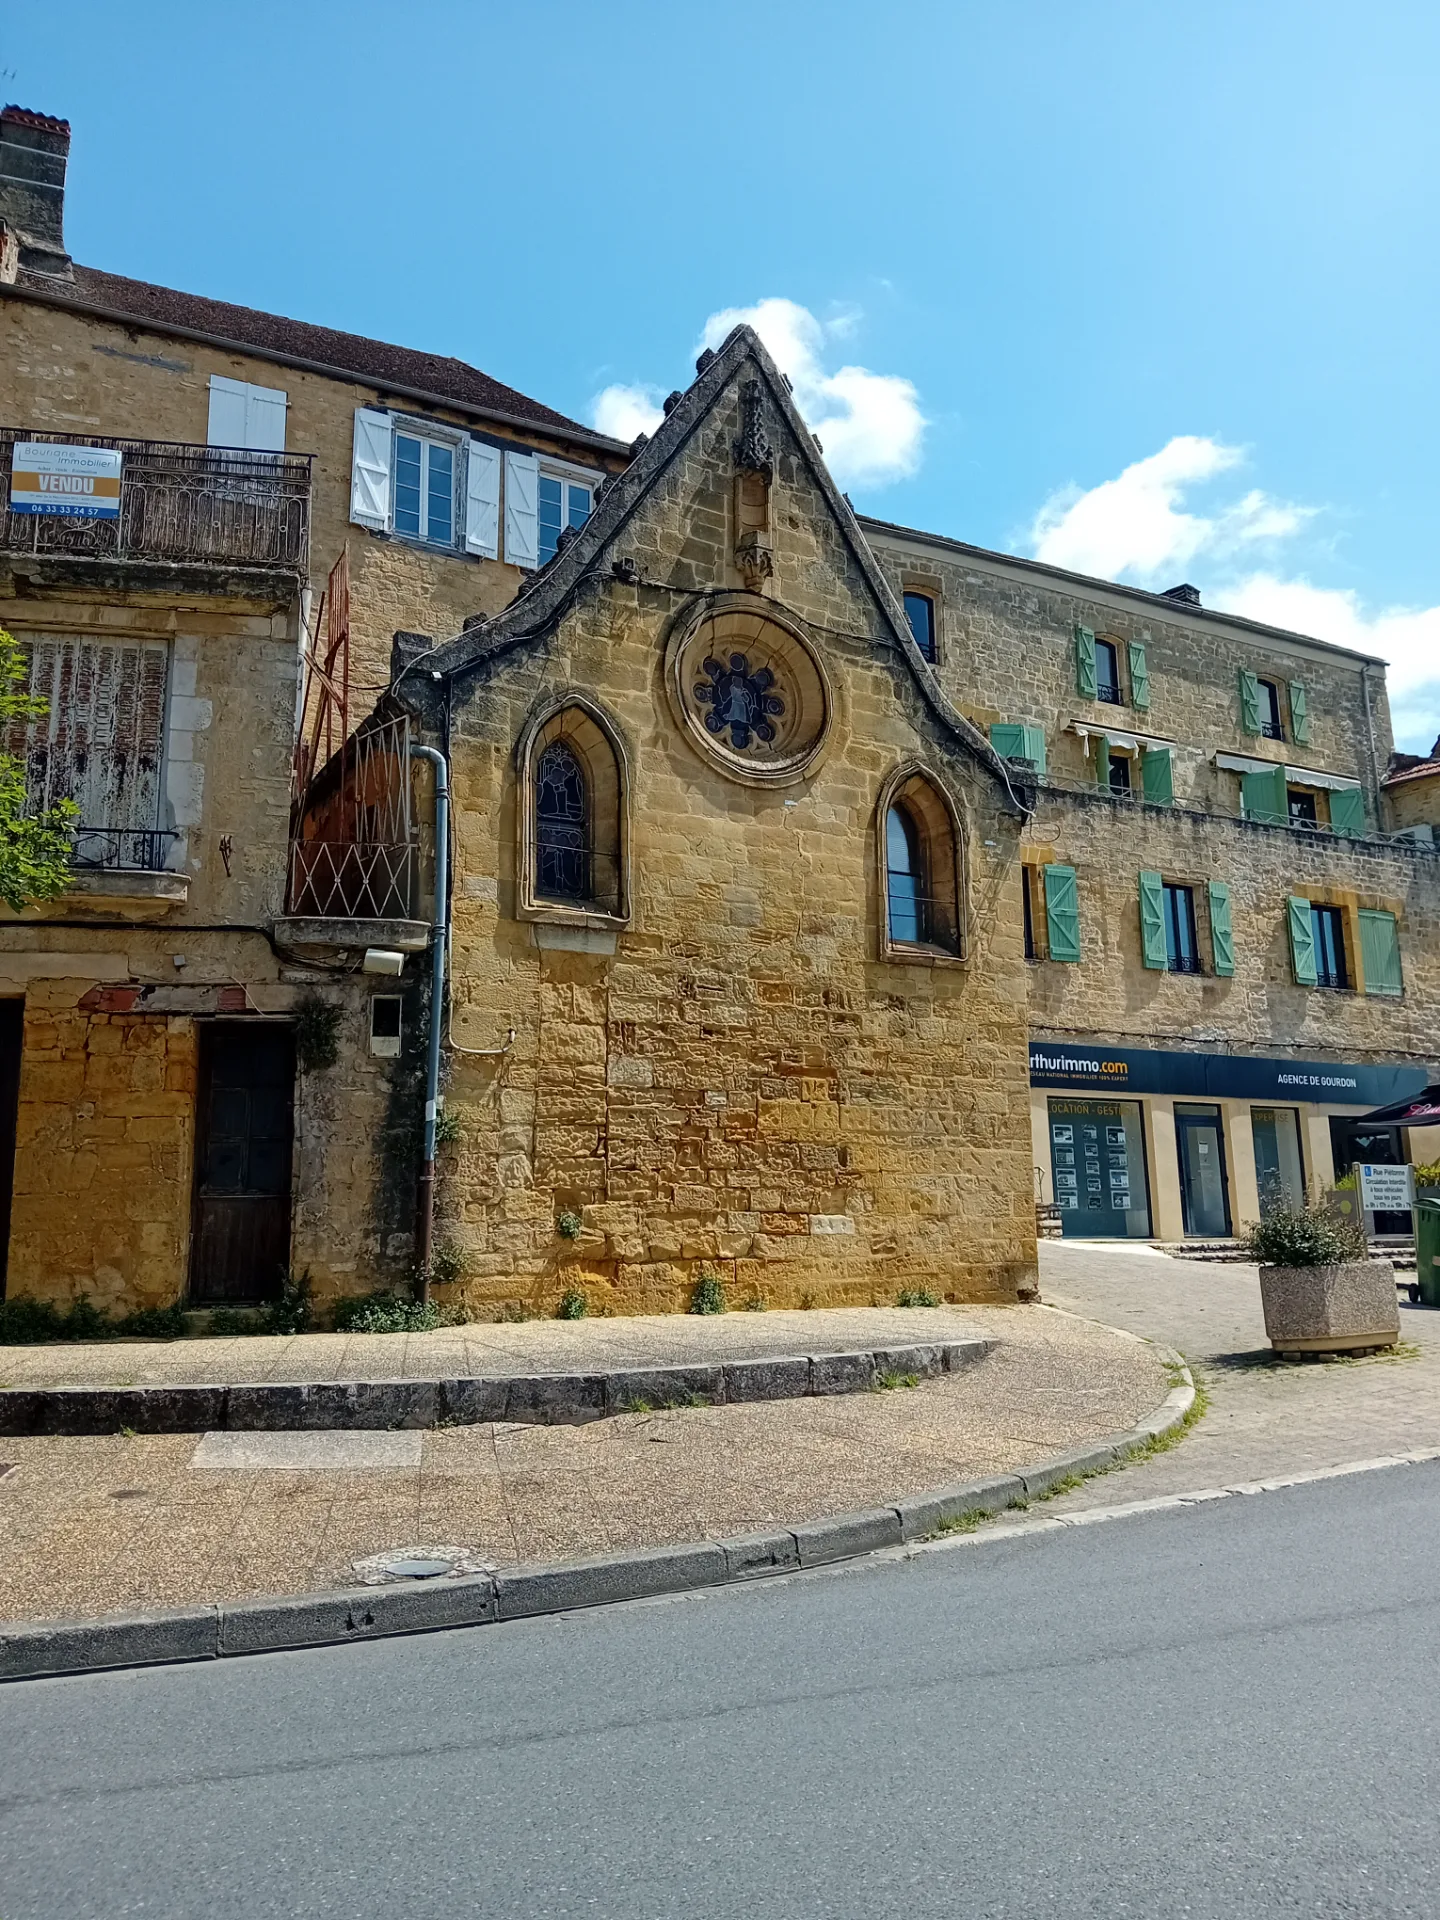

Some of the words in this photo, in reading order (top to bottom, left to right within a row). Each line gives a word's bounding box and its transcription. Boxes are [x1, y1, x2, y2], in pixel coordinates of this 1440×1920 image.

[25, 447, 76, 458] Bouriane
[58, 457, 111, 467] Immobilier
[38, 474, 95, 494] VENDU
[31, 504, 43, 513] 06
[46, 505, 57, 513] 33
[59, 506, 71, 514] 33
[73, 507, 85, 515] 24
[87, 508, 99, 516] 57
[1029, 1053, 1128, 1073] rthurimmo.com
[1277, 1073, 1309, 1085] AGENCE
[1309, 1075, 1320, 1086] DE
[1320, 1076, 1357, 1088] GOURDON
[1049, 1103, 1090, 1115] OCATION
[1252, 1112, 1289, 1123] XPERTISE
